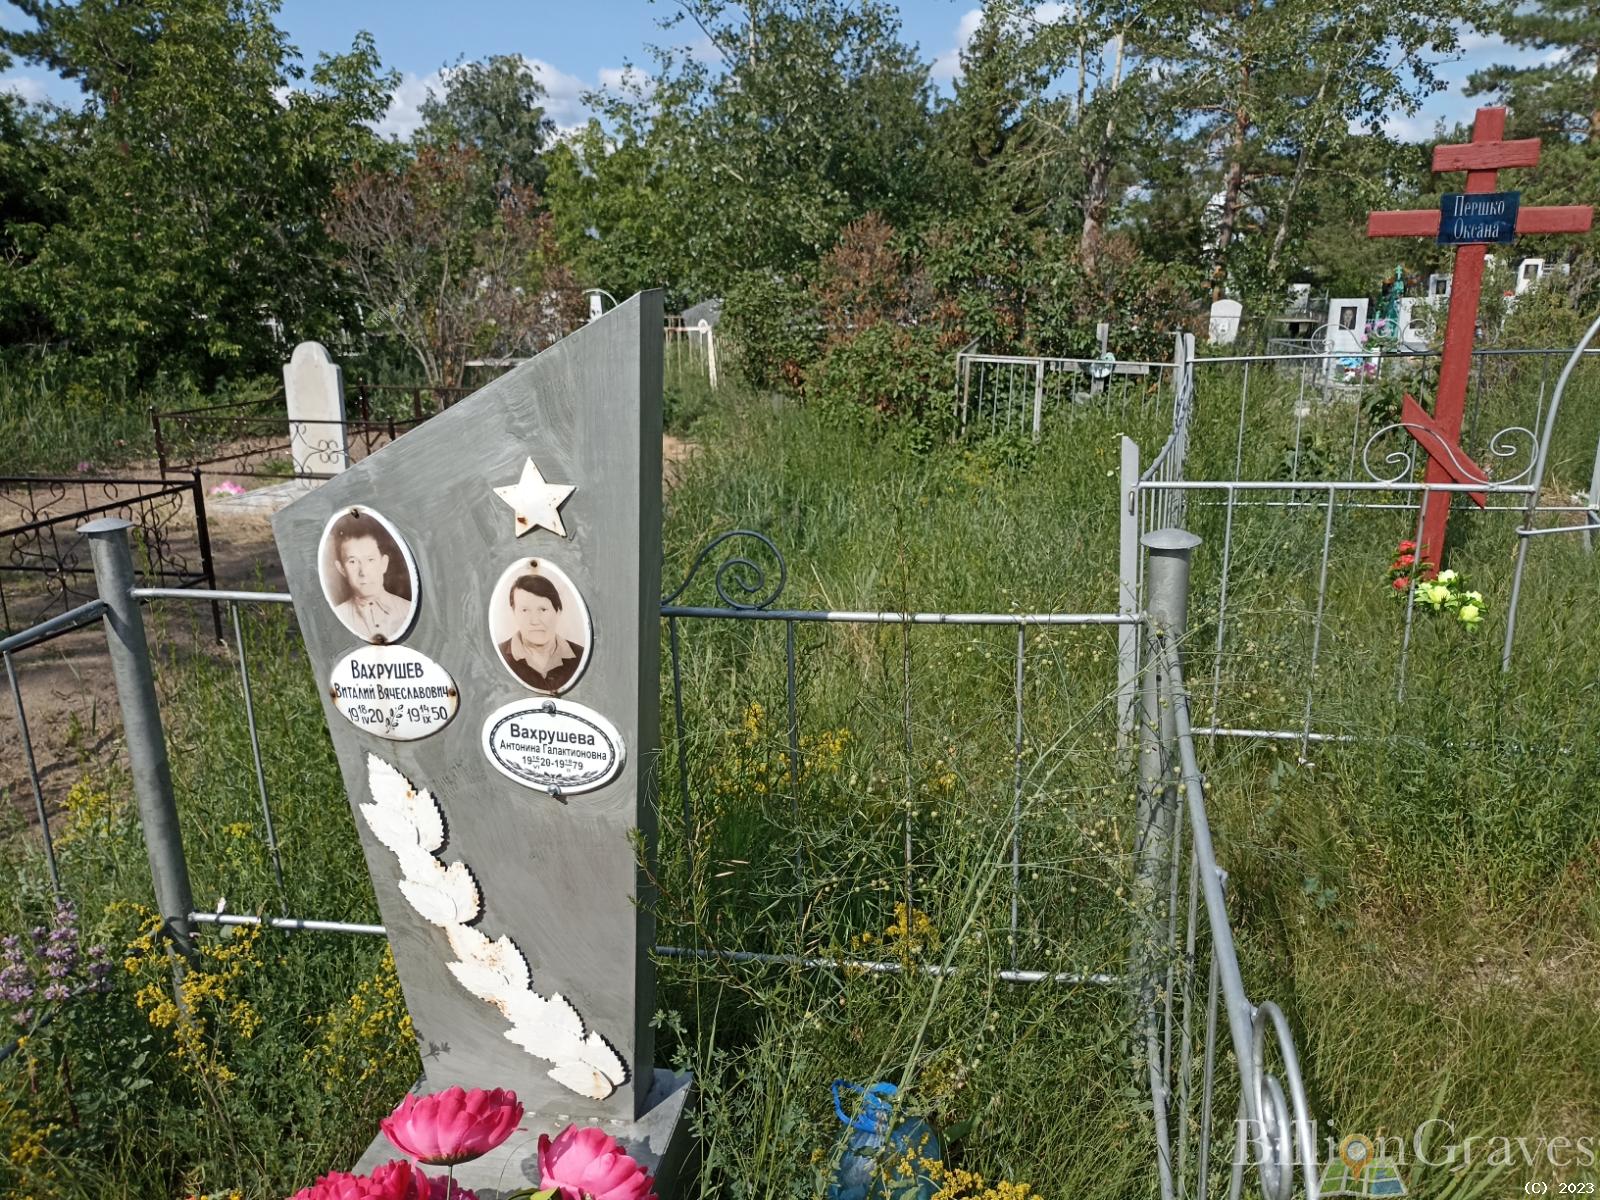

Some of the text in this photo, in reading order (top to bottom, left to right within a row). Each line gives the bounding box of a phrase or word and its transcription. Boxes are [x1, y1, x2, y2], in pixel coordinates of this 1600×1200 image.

[1454, 195, 1505, 217] Першко
[1454, 217, 1500, 239] Оксана
[350, 659, 424, 679] ВАХРУШЕВ
[510, 722, 595, 746] Вахрушева
[500, 739, 541, 754] Антонина
